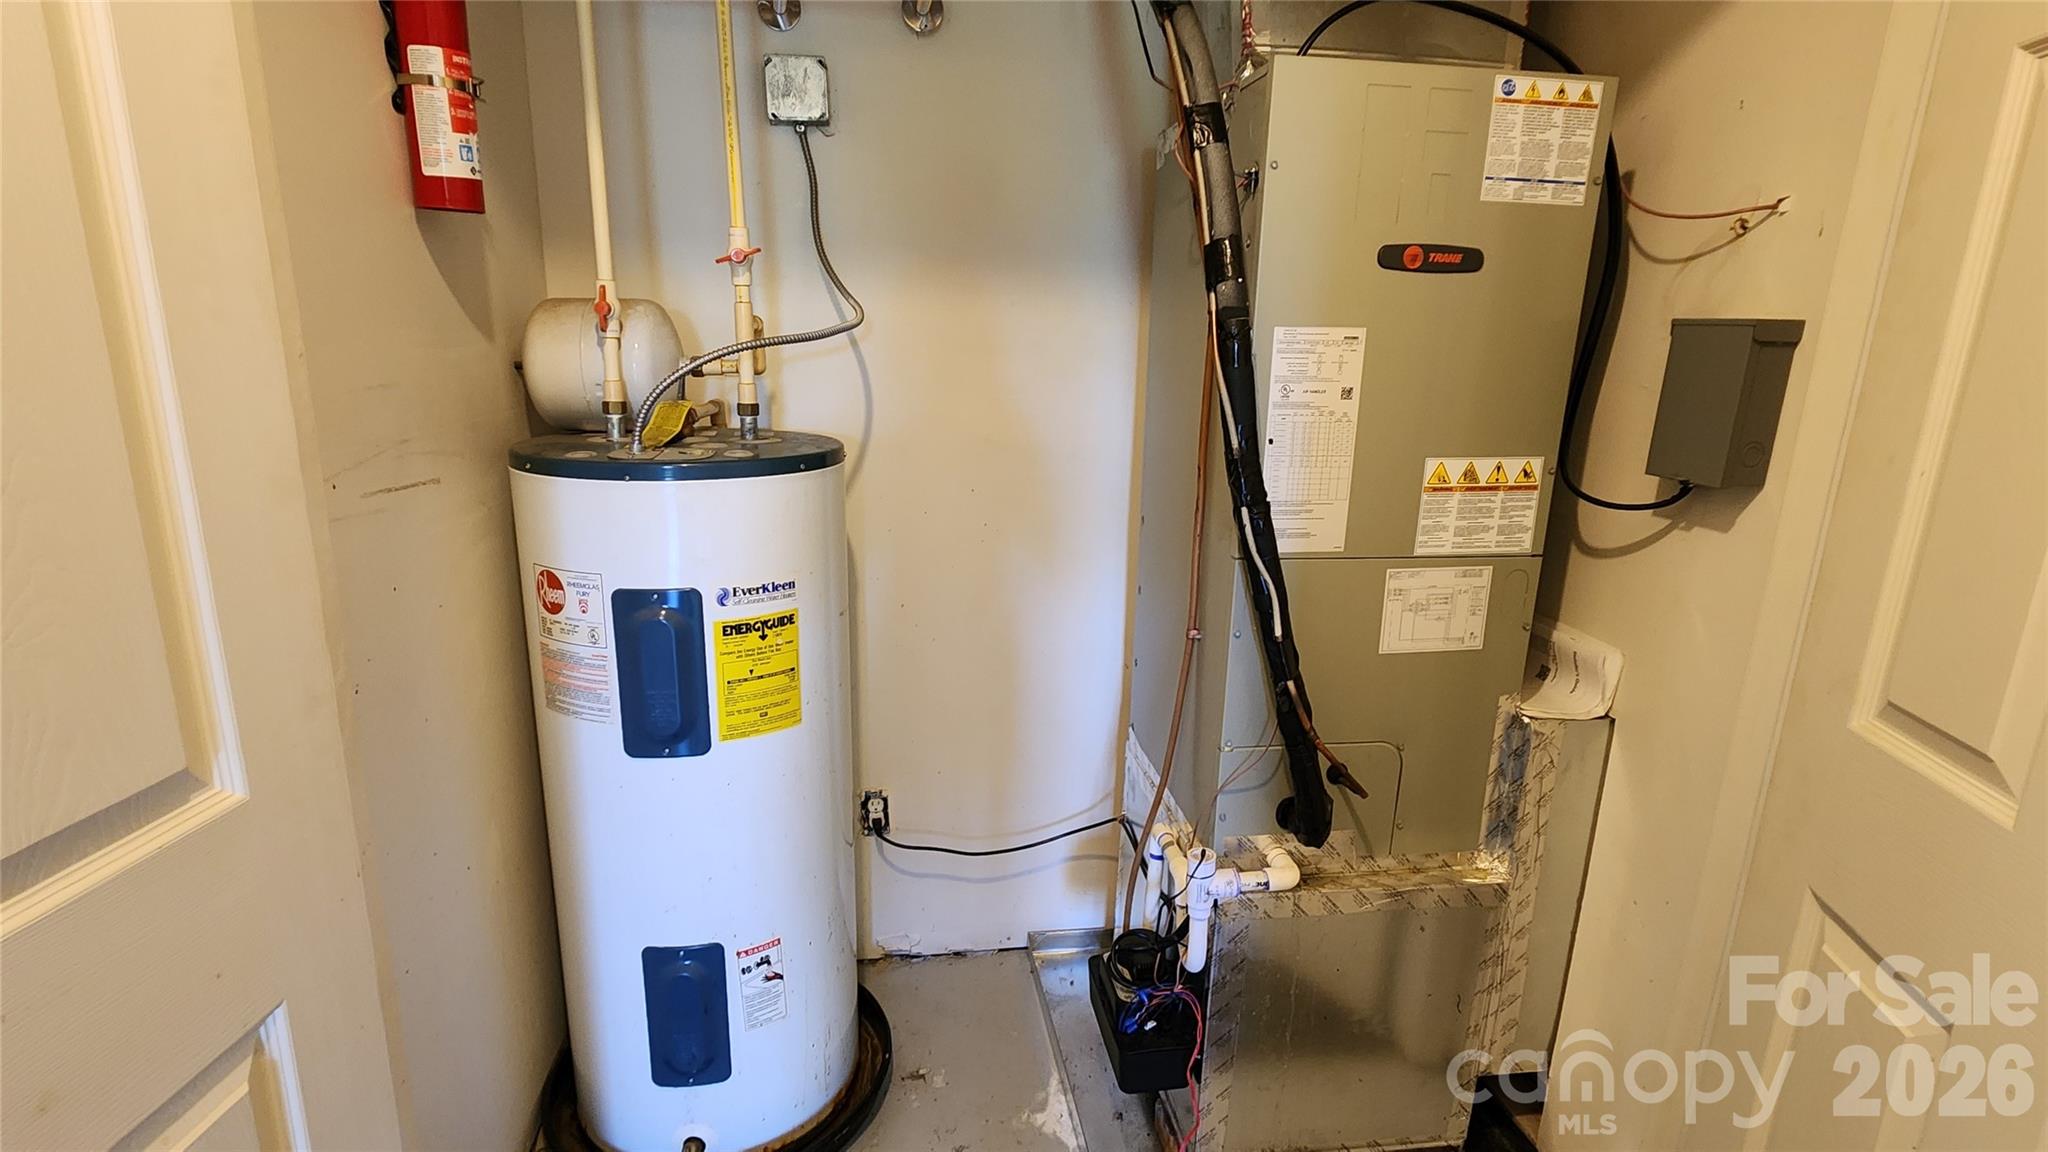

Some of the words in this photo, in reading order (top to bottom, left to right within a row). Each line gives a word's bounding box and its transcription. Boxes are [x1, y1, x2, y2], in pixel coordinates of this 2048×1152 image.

[1428, 252, 1464, 264] TRANE
[538, 571, 565, 609] Rheem
[732, 580, 796, 598] EverKleen
[722, 613, 796, 637] ENERGYGUIDE
[748, 940, 779, 955] DANGER
